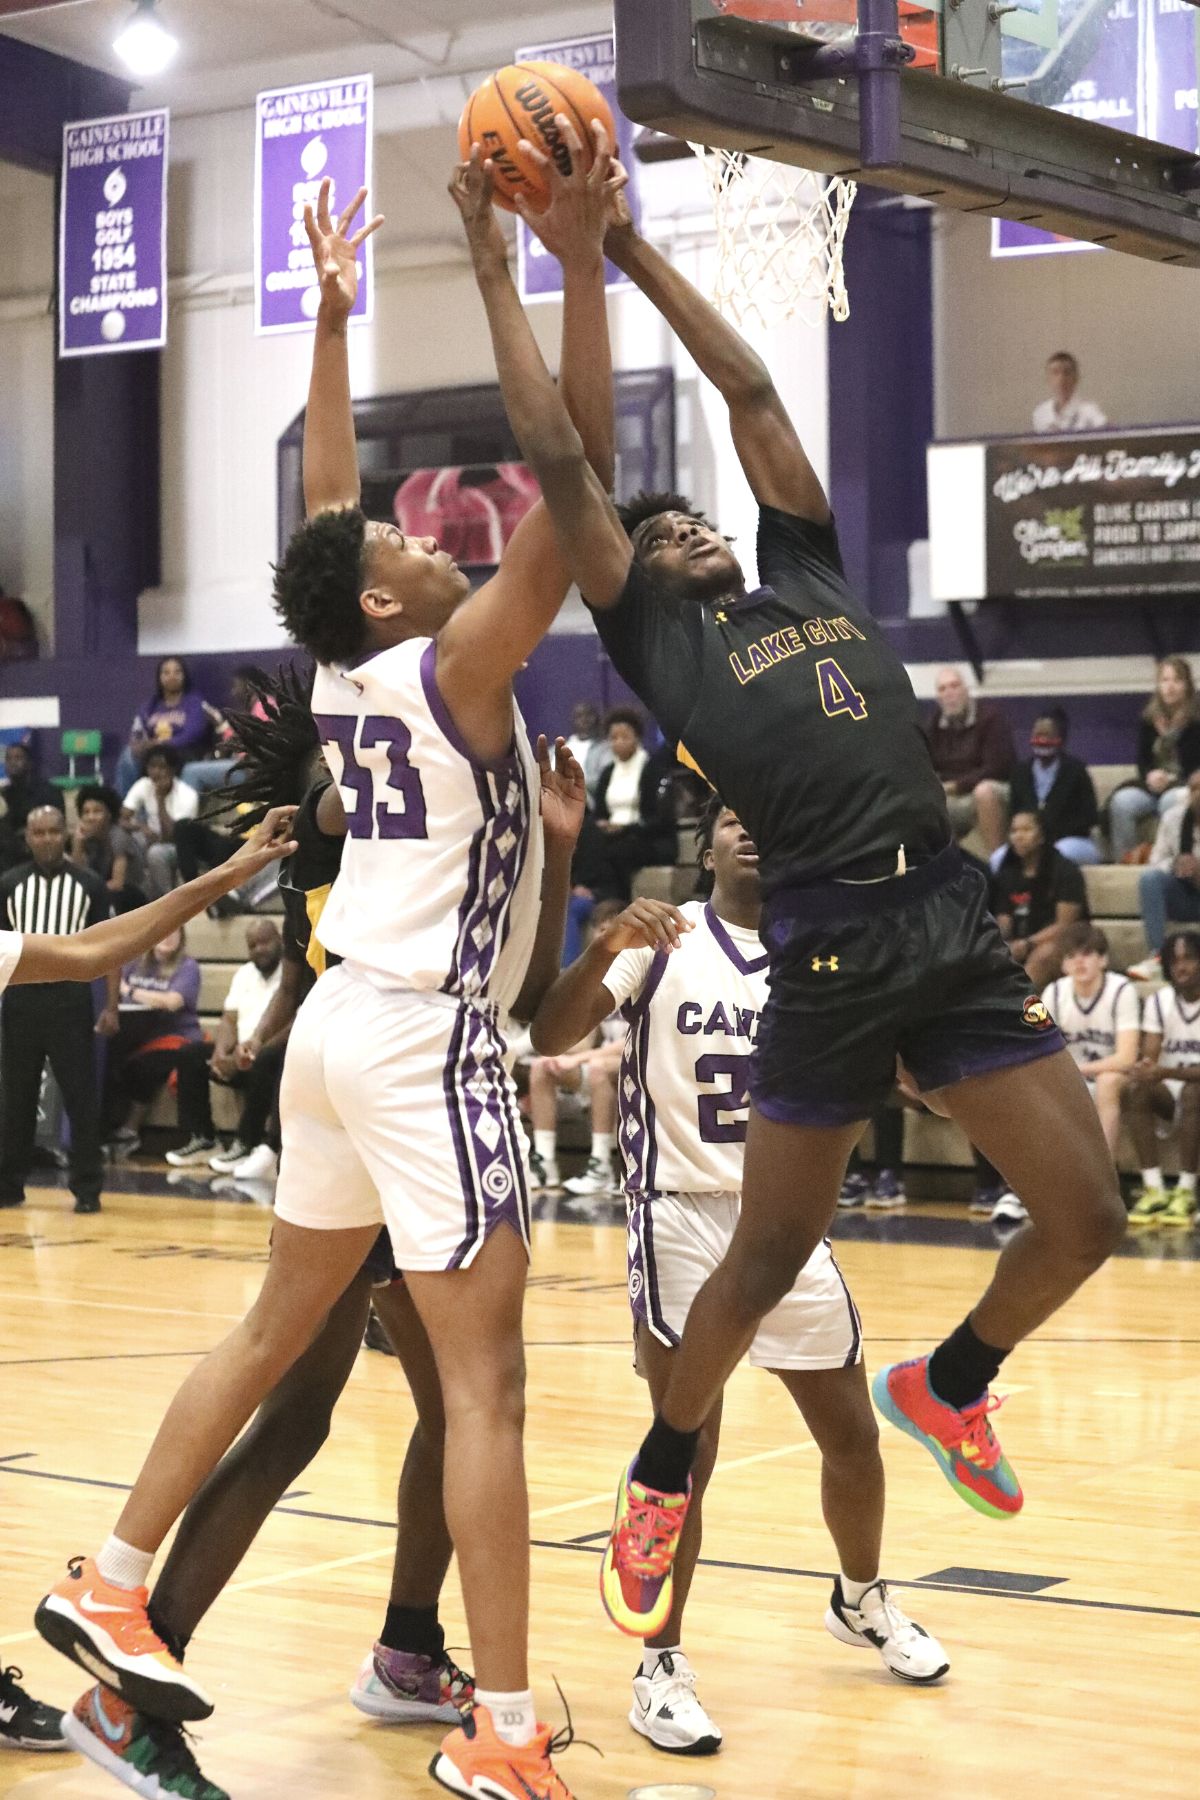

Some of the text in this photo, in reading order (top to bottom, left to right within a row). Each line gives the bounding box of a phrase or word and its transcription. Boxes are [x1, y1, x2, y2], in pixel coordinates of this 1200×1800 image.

[262, 83, 367, 119] GAINESVILLE
[68, 117, 164, 150] GAINESVILLE
[264, 105, 365, 138] HIGH SCHOOL
[70, 138, 162, 169] HIGH SCHOOL
[95, 207, 133, 229] BOYS
[95, 226, 133, 247] GOLF
[91, 242, 137, 272] 1954
[90, 270, 137, 294] STATE
[69, 287, 158, 315] CHAMPIONS
[1062, 453, 1103, 484] All
[1104, 450, 1188, 488] Family
[1142, 522, 1161, 543] TO
[728, 626, 806, 686] LAKE
[815, 657, 869, 721] 4
[312, 712, 430, 840] 33
